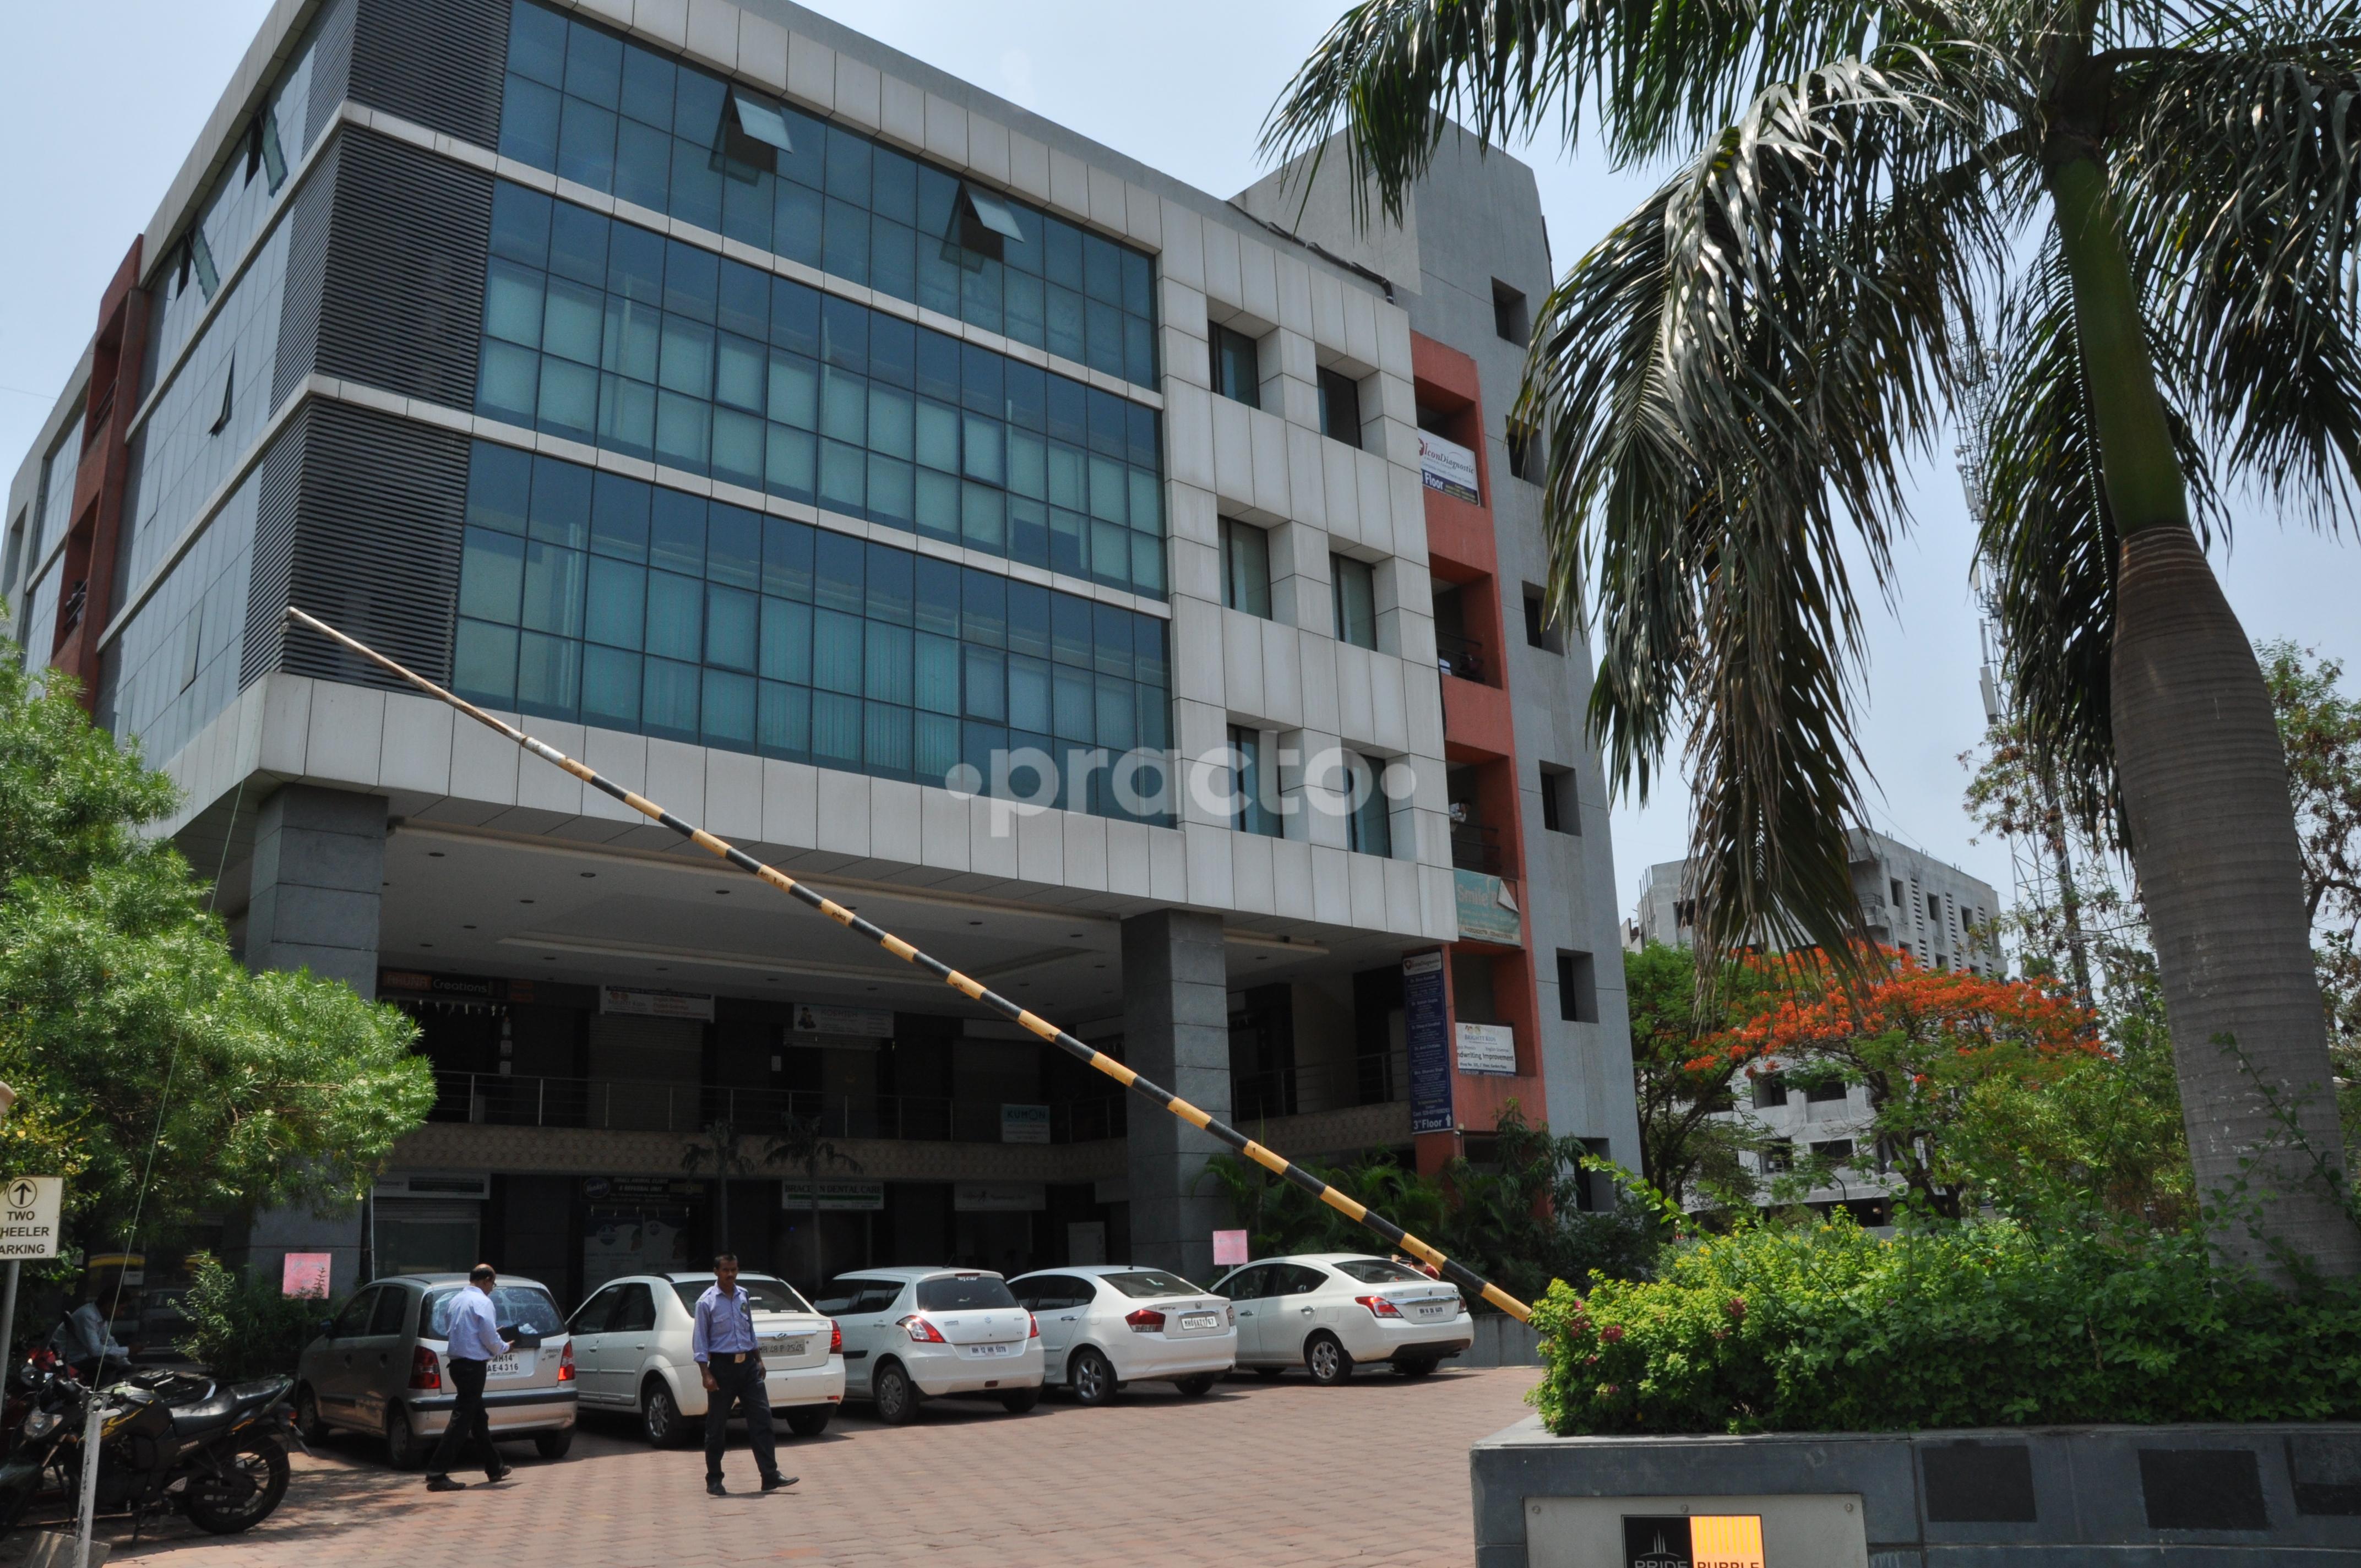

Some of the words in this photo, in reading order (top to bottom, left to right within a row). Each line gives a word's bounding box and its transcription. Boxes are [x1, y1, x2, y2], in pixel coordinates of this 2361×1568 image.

[1424, 442, 1475, 474] iconDiagnostic
[1424, 471, 1444, 490] Floor
[1456, 884, 1488, 906] Smile
[433, 978, 488, 994] Creations
[1483, 1051, 1514, 1061] Improvement
[1007, 1109, 1046, 1120] KUMON
[1422, 1118, 1442, 1129] Floor
[7, 1211, 35, 1221] TWO
[180, 1440, 199, 1450] YAMAHA
